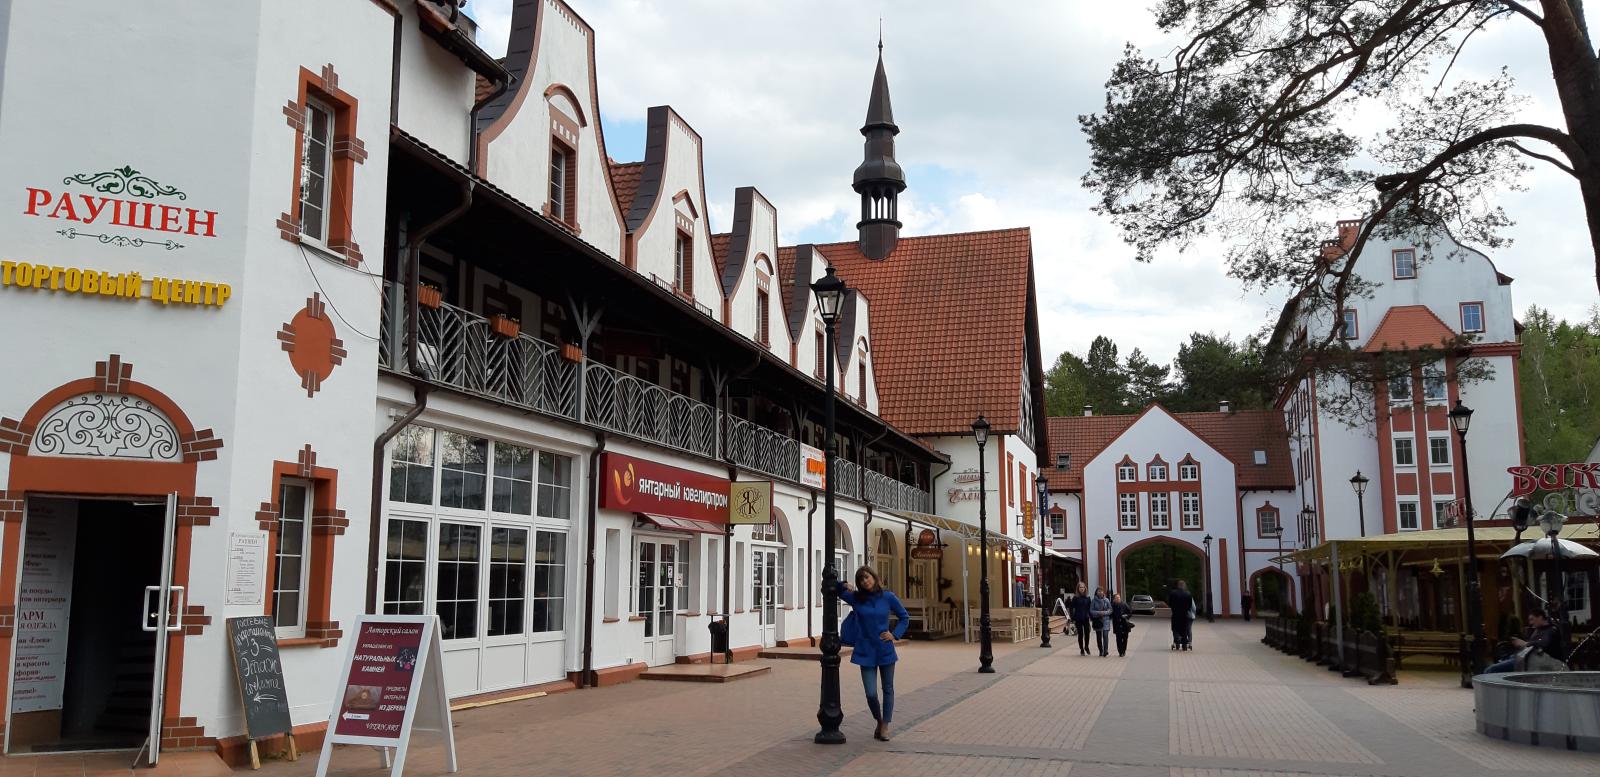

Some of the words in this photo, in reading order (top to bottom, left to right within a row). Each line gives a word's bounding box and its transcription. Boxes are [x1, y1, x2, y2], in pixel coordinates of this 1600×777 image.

[24, 187, 219, 238] РАУШЕН
[1, 260, 142, 299] ТОРГОВЫЙ
[151, 277, 232, 306] ЦЕНТР
[639, 478, 681, 502] янтарный
[683, 486, 728, 511] ювелирпром
[948, 488, 980, 504] Елен
[251, 638, 259, 656] 3
[353, 654, 397, 663] НАТУРАЛЬНЫХ
[361, 665, 386, 673] КАМНЕЙ
[386, 704, 406, 712] ДЕРЕВА
